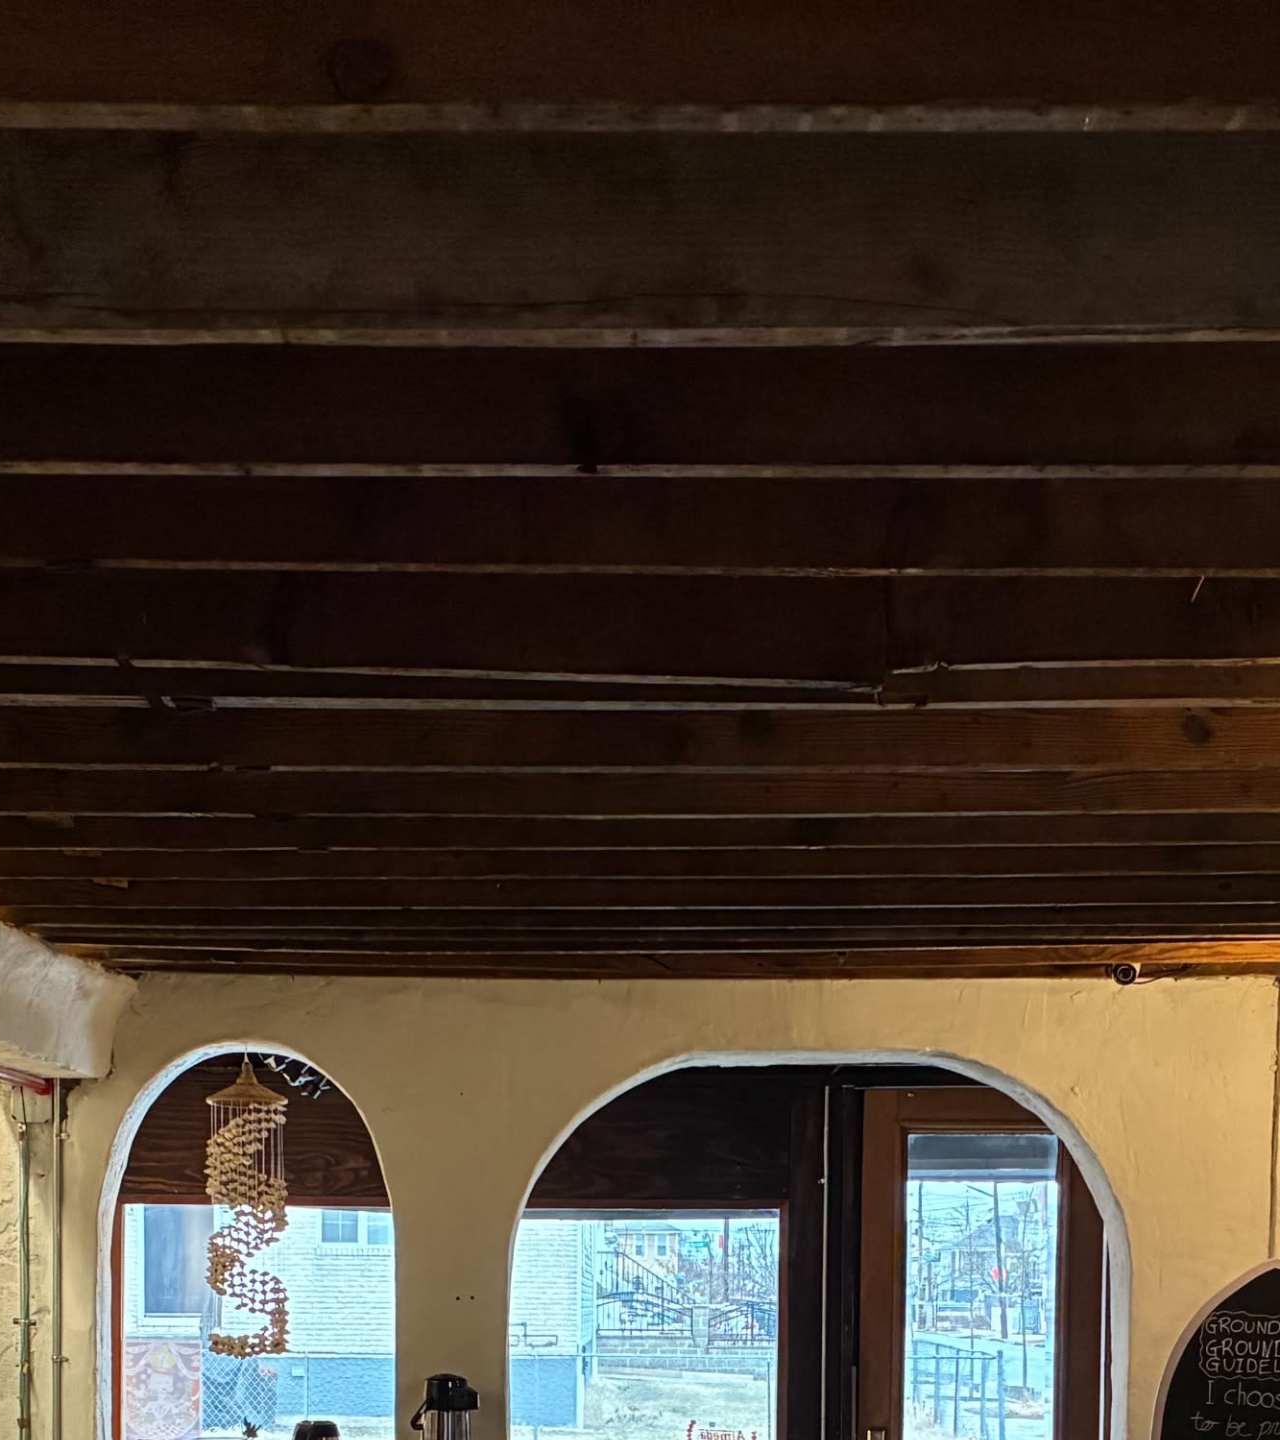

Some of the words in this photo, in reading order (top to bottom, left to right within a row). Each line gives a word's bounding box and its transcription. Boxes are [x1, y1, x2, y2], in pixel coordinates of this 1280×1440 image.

[1205, 1380, 1215, 1405] I
[1190, 1411, 1220, 1432] to
[1225, 1414, 1252, 1438] be
